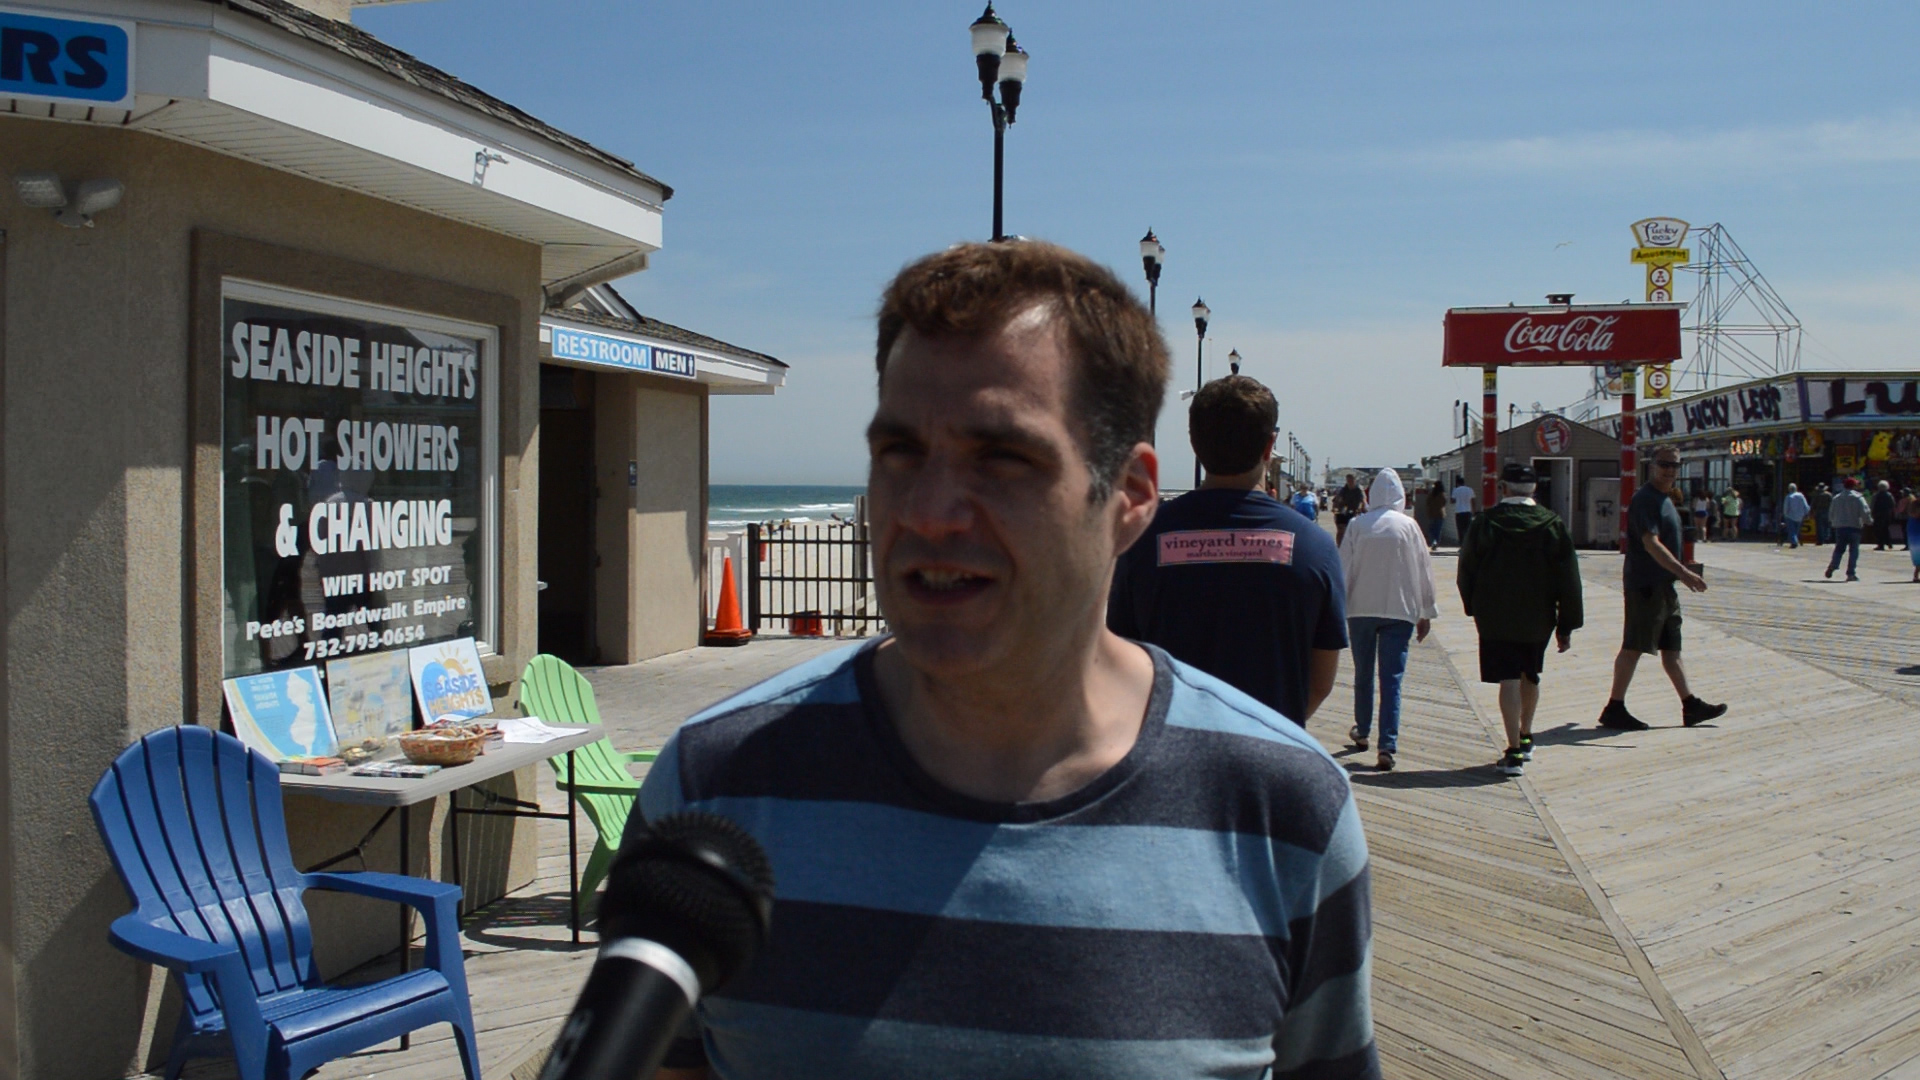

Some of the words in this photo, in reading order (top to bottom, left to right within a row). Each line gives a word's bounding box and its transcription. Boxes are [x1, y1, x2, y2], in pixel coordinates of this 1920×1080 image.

[0, 27, 108, 89] RS
[557, 333, 647, 366] RESTROOM
[655, 350, 687, 374] MEN
[1504, 315, 1620, 353] Coca-Cola
[231, 321, 360, 389] SEASIDE
[370, 341, 475, 400] HEIGHTS
[256, 415, 325, 472] HOT
[336, 419, 459, 472] SHOWERS
[1730, 439, 1761, 455] CANDY
[275, 503, 299, 558] &
[308, 499, 452, 555] CHANGING
[1164, 533, 1235, 551] vineyard
[1240, 535, 1284, 549] vines
[1186, 550, 1224, 558] martha's
[1225, 549, 1263, 560] vineyard
[322, 573, 363, 597] WIFI
[369, 569, 406, 592] HOT
[411, 565, 452, 587] SPOT
[246, 615, 305, 641] Pete's
[312, 601, 408, 631] Boardwalk
[413, 595, 466, 618] Empire
[303, 624, 426, 661] 732-793-0654
